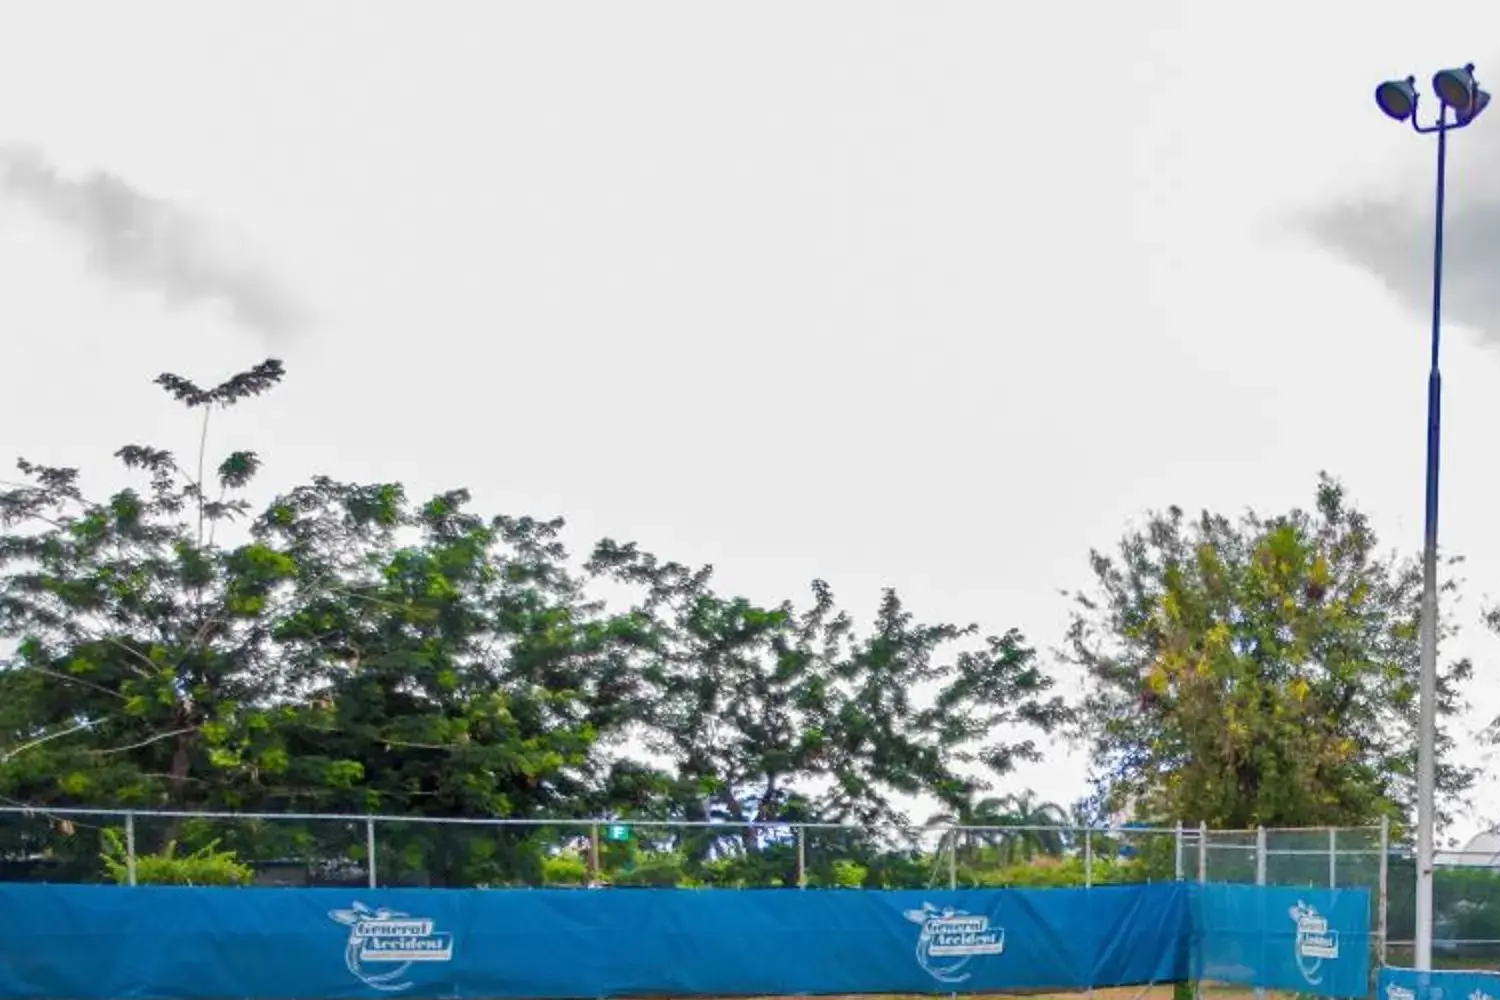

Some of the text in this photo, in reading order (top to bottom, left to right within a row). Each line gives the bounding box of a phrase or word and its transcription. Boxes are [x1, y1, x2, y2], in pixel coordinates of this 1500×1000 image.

[357, 921, 427, 934] General
[368, 936, 442, 950] Accident
[934, 932, 997, 945] Accident
